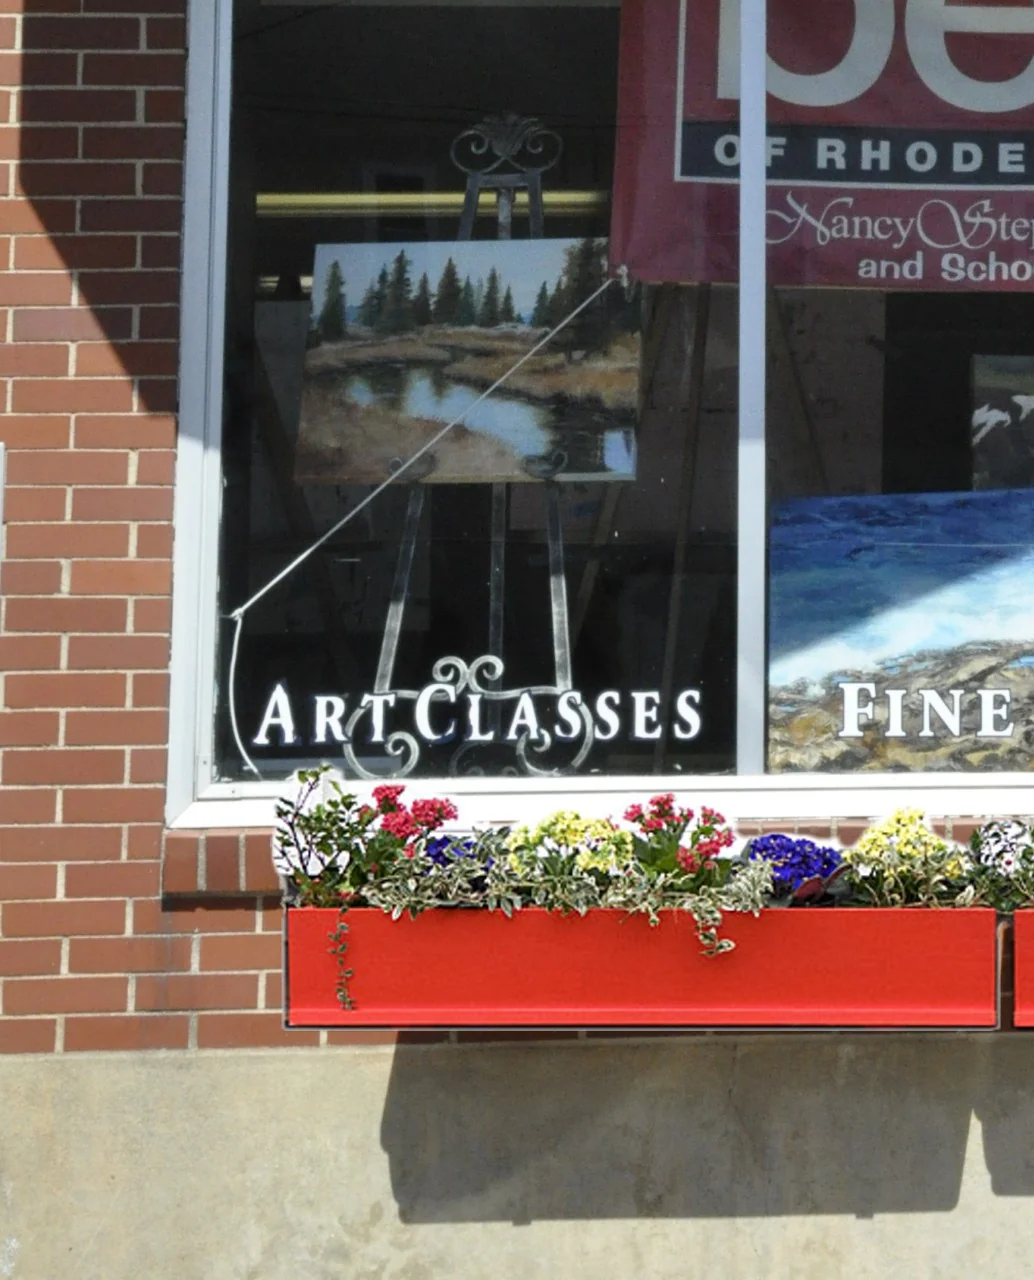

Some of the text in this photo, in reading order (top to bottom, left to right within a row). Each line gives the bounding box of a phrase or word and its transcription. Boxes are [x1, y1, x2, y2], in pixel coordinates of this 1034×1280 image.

[714, 134, 787, 167] OF
[816, 137, 1026, 173] RHODE
[765, 191, 914, 250] Nancy
[858, 251, 923, 280] and
[252, 683, 703, 746] ART CLASSES
[838, 681, 1015, 738] FINE
